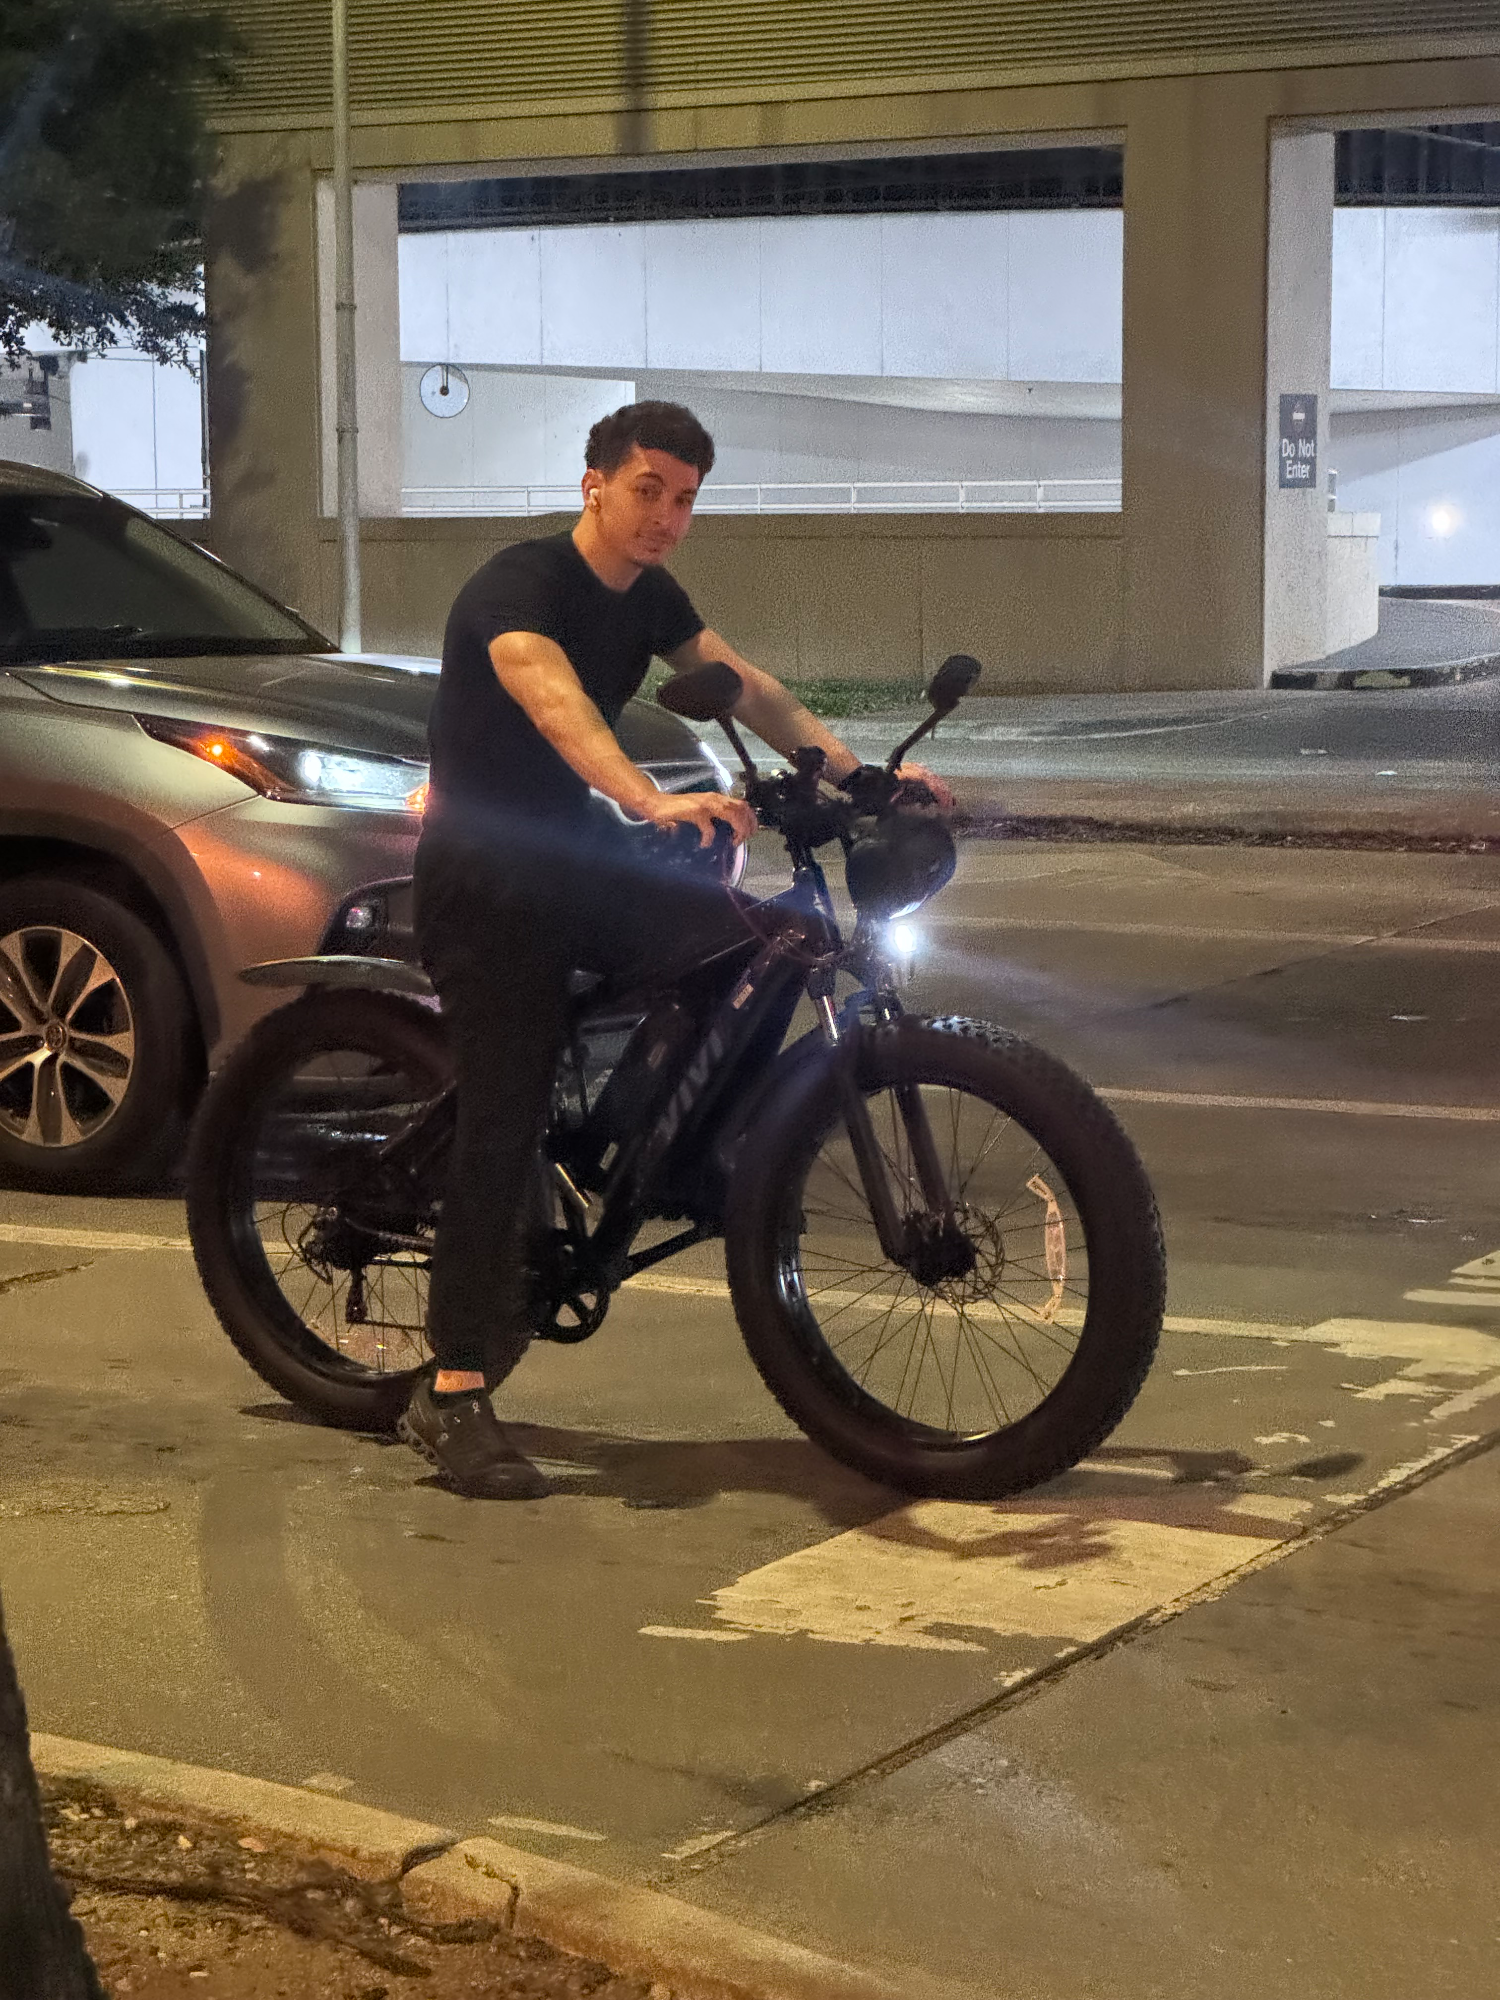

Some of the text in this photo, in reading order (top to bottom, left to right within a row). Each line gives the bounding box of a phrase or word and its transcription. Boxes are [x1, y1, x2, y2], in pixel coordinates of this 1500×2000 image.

[1281, 438, 1315, 458] Do Not
[1285, 459, 1310, 479] Enter
